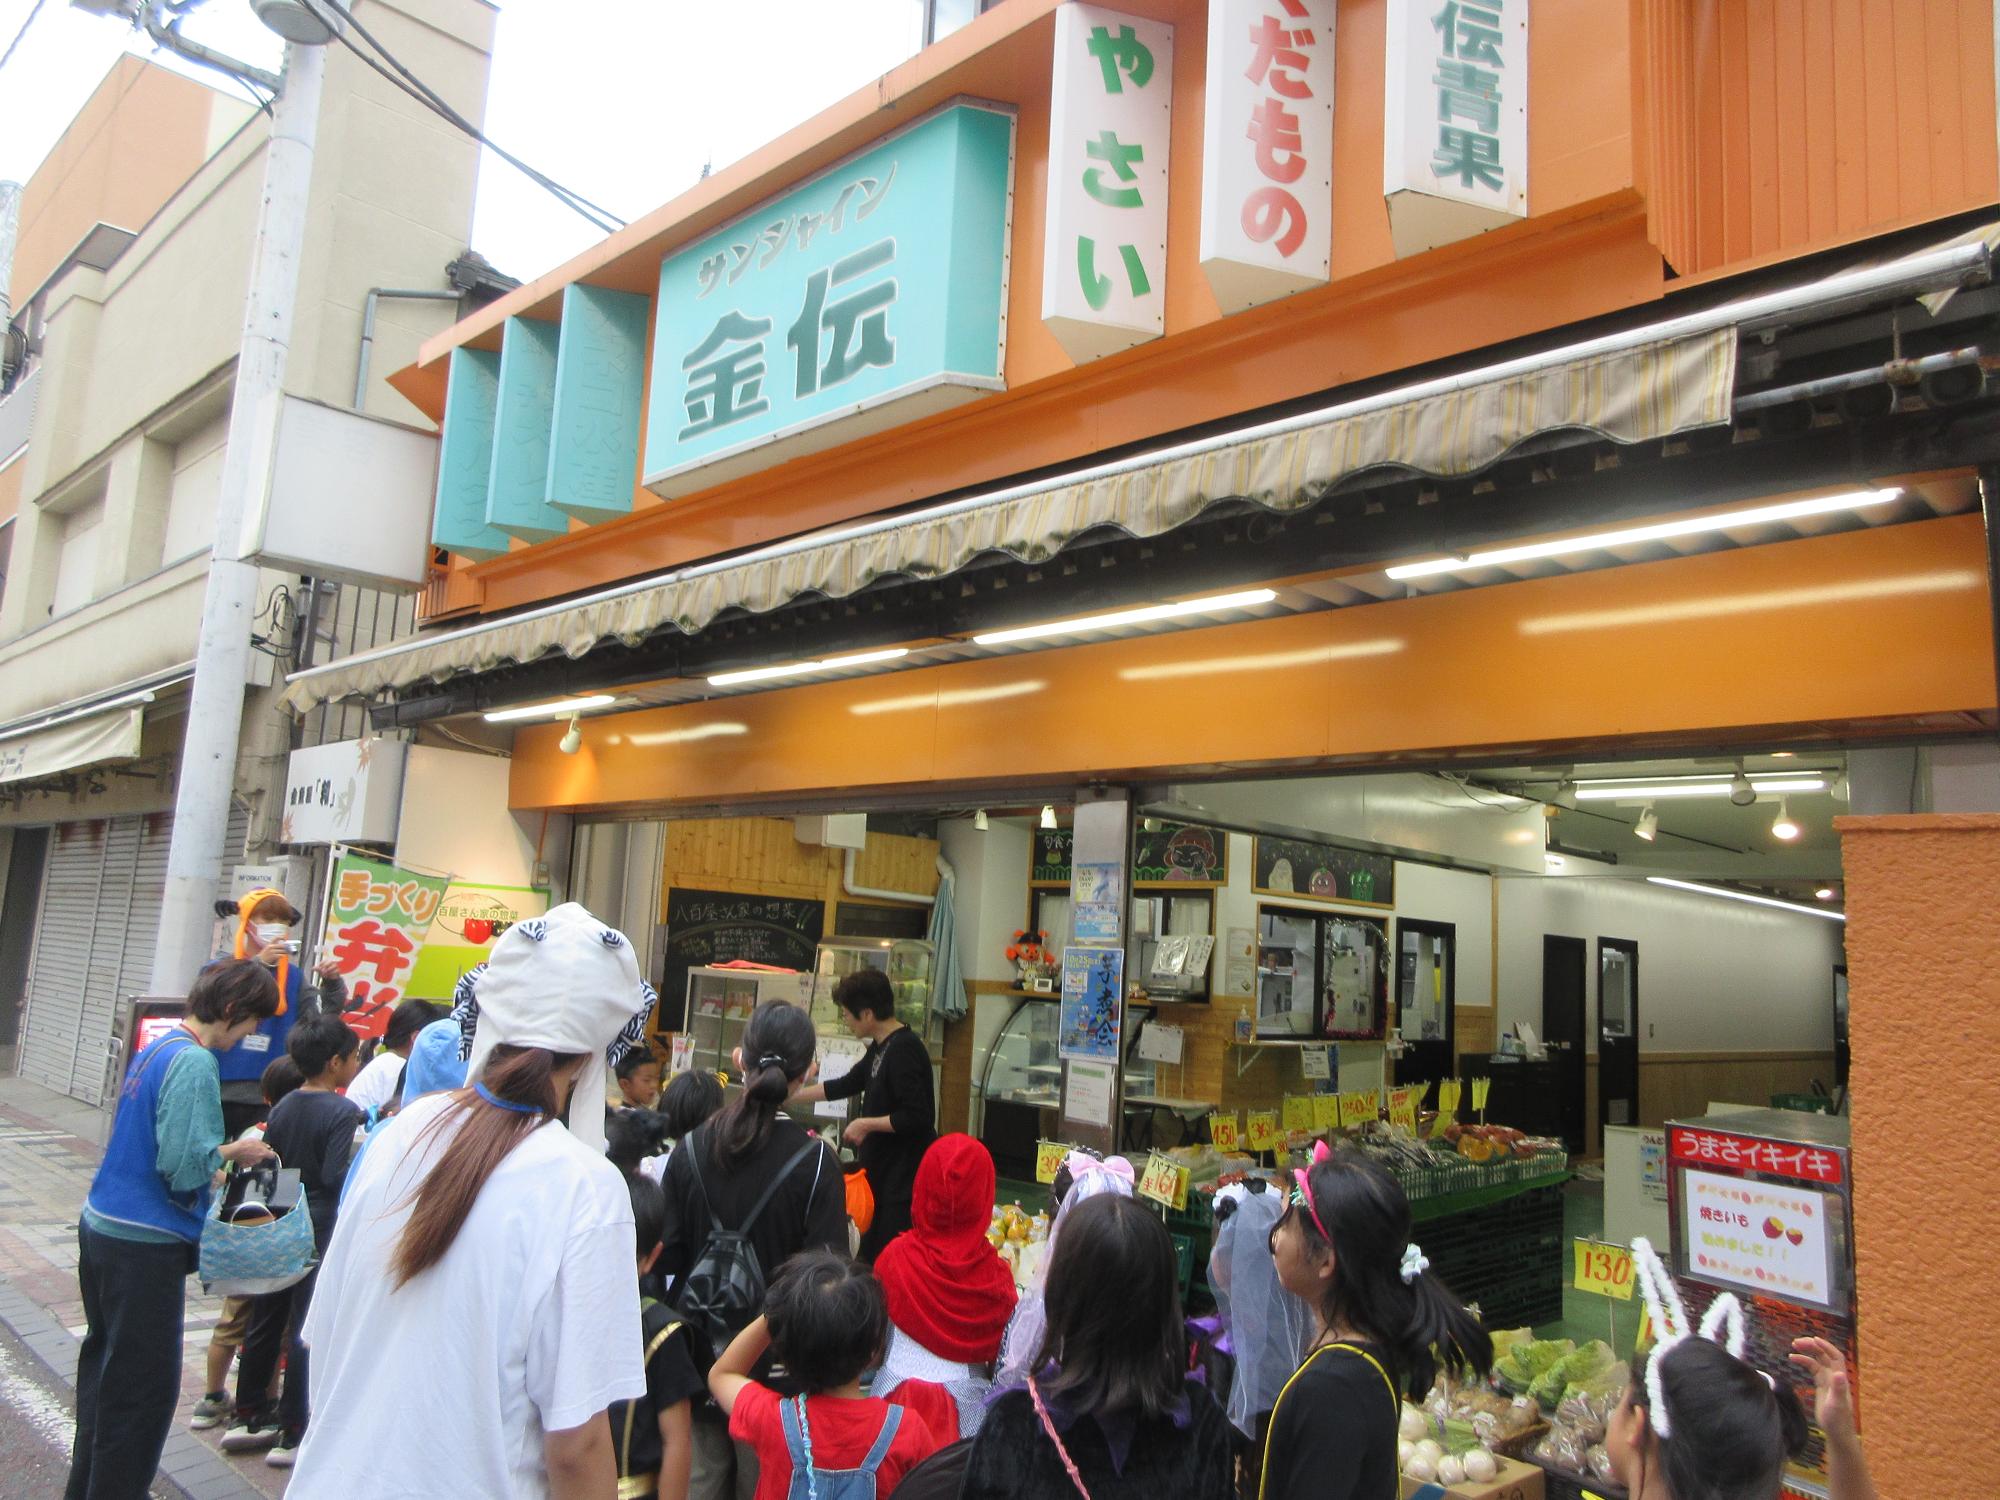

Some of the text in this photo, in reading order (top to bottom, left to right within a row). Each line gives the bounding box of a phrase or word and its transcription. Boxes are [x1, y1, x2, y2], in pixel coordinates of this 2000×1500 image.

[1241, 0, 1316, 259] だもの
[1430, 0, 1505, 193] 伝青果
[1077, 23, 1155, 311] やさい
[696, 161, 898, 300] サンシャイン
[677, 236, 899, 444] 金伝
[338, 872, 440, 922] 手づくり
[434, 904, 519, 920] 百屋さん家の惣菜
[333, 920, 414, 1040] 弁当
[1679, 1131, 1832, 1178] うまさイキイキ
[1584, 1251, 1632, 1285] 130
[1700, 1205, 1749, 1228] 焼きいも
